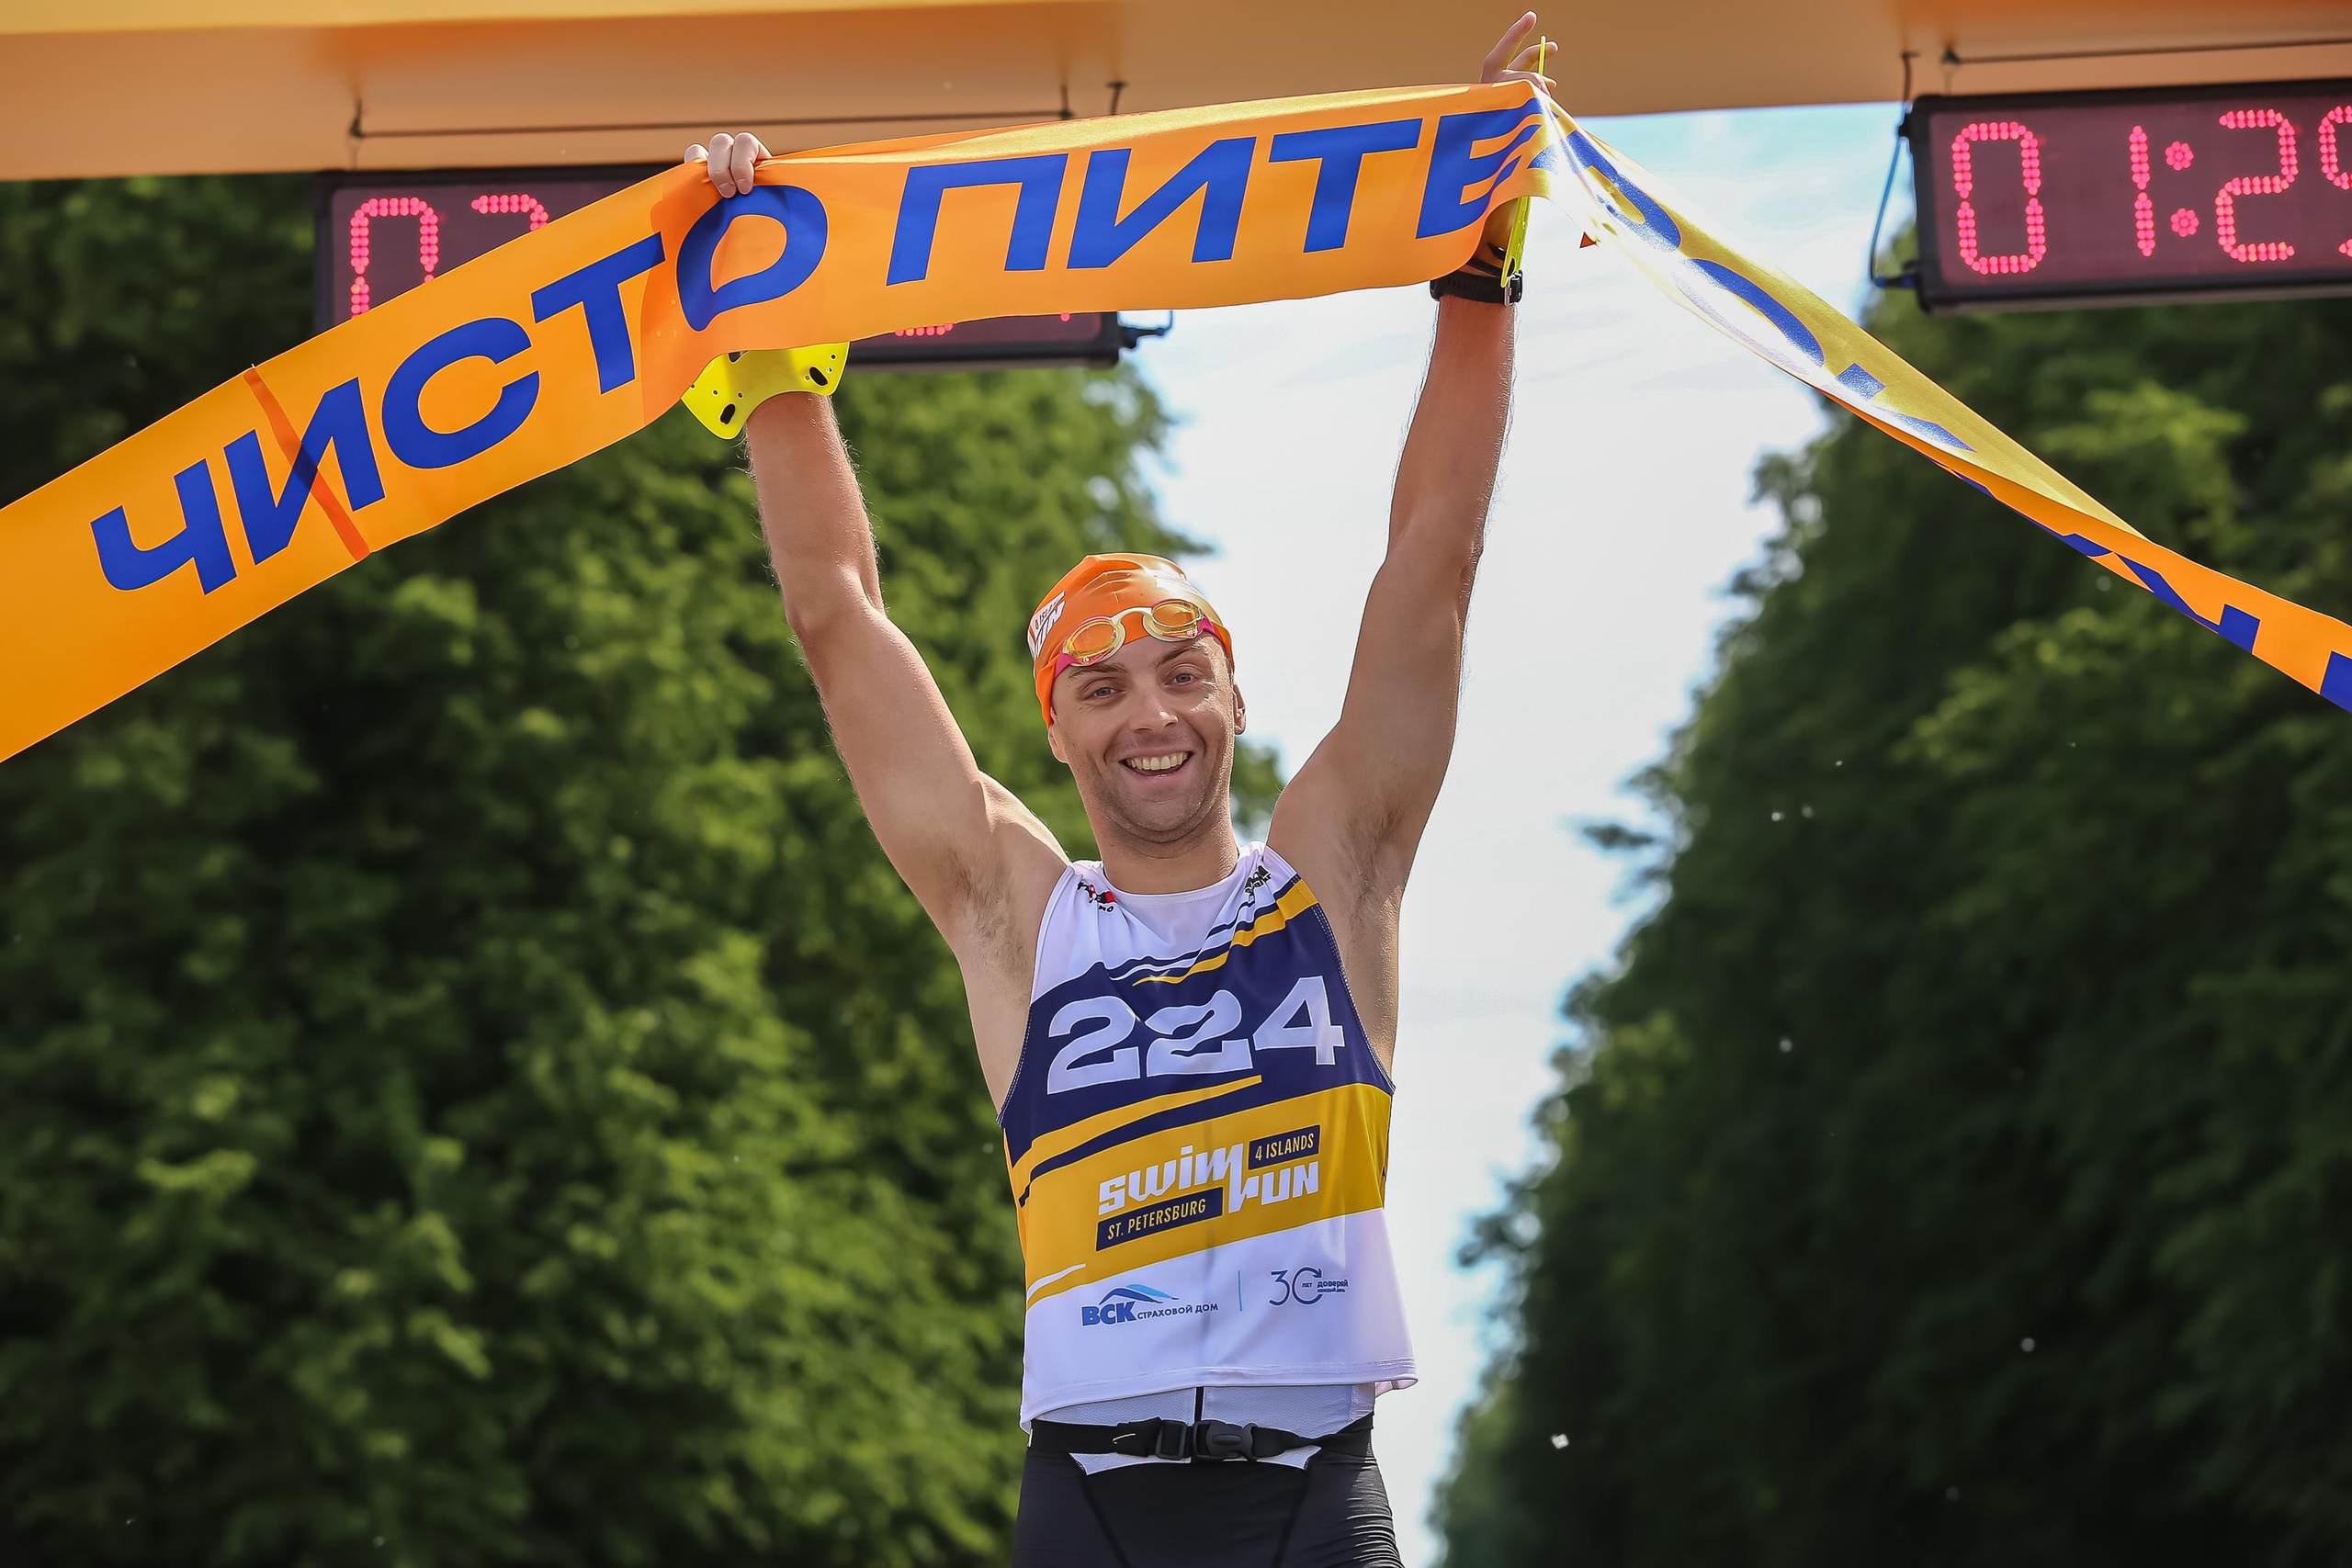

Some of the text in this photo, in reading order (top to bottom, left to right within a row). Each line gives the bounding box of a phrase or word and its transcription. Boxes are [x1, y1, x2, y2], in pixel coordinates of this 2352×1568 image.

[90, 185, 828, 595] ЧИСТО
[1047, 976, 1345, 1095] 224
[1255, 1133, 1316, 1161] 4 ISLANDS
[1107, 1199, 1206, 1240] ST. PETERSBURG
[1081, 1301, 1218, 1326] ВСК СТРАХОВОЙ ДОМ
